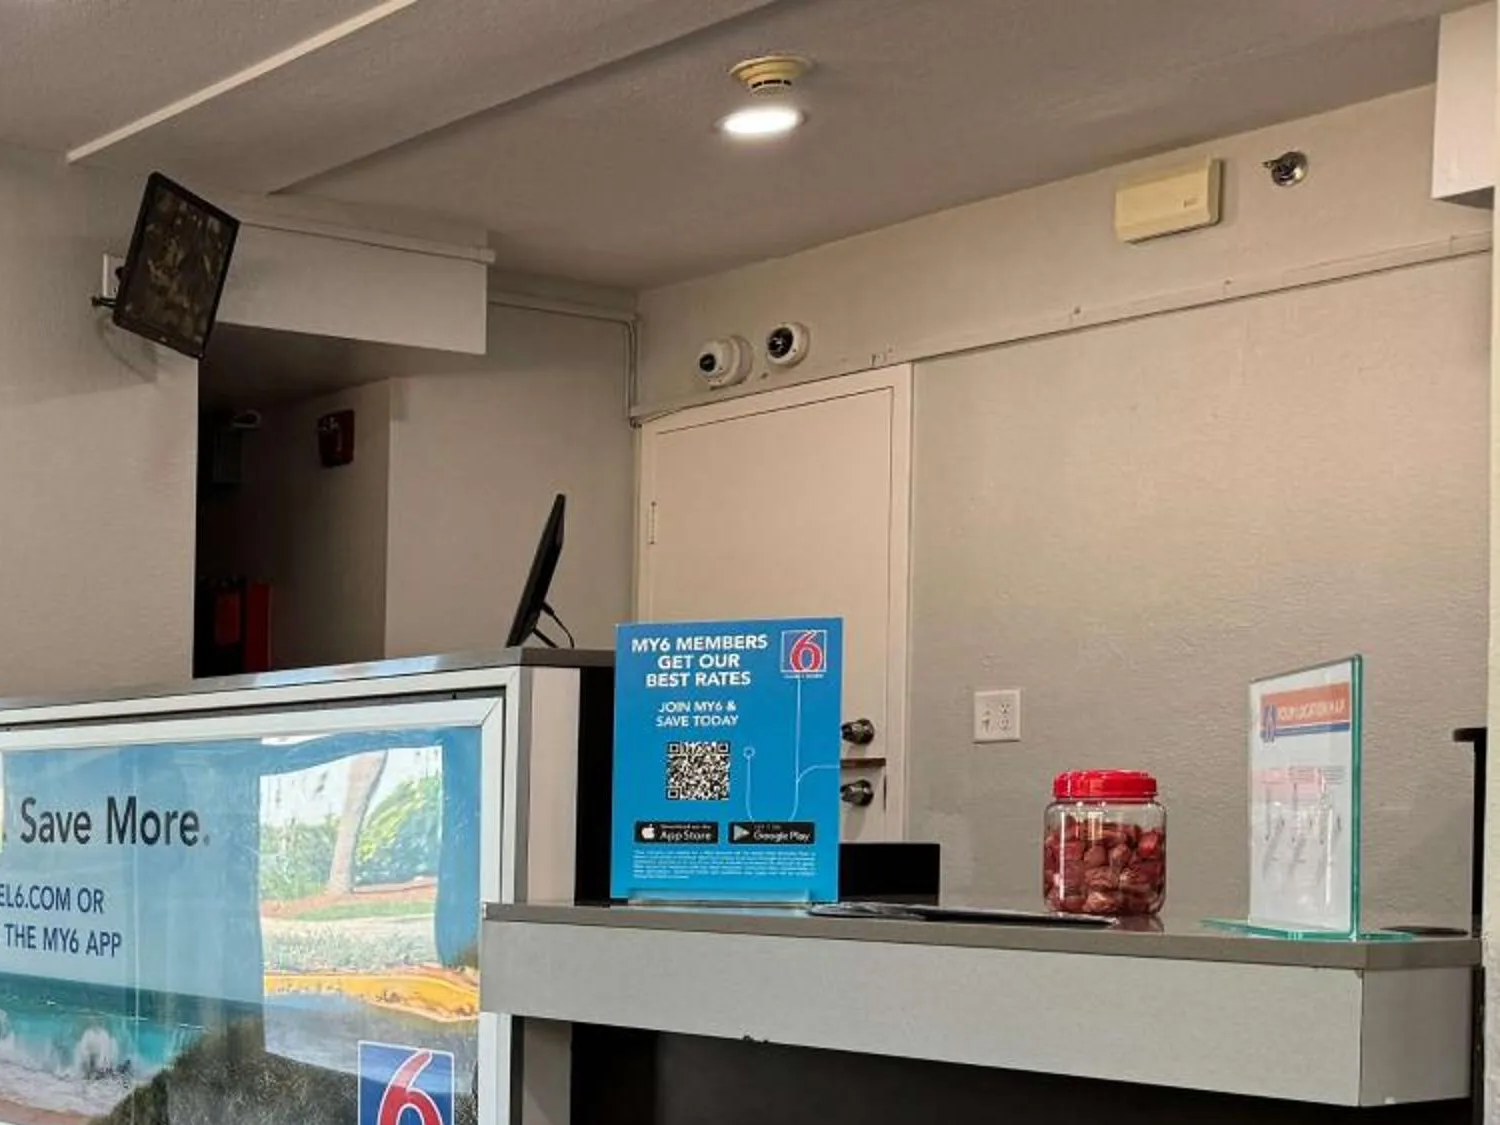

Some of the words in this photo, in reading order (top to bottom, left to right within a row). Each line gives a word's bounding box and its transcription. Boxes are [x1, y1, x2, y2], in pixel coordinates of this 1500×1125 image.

[631, 637, 671, 653] MY6
[675, 633, 768, 652] MEMBERS
[657, 655, 694, 670] GET
[699, 653, 741, 668] OUR
[646, 672, 690, 688] BEST
[695, 671, 752, 687] RATES
[658, 700, 691, 713] JOIN
[693, 700, 723, 713] MY6
[726, 699, 737, 712] &
[655, 715, 690, 727] SAVE
[692, 714, 739, 727] TODAY
[20, 797, 92, 845] Save
[659, 830, 683, 841] App
[684, 829, 712, 841] Store
[753, 830, 788, 843] Google
[790, 830, 810, 842] Play
[77, 887, 104, 914] OR
[4, 922, 37, 950] THE
[43, 928, 79, 954] MY6
[85, 931, 122, 958] APP
